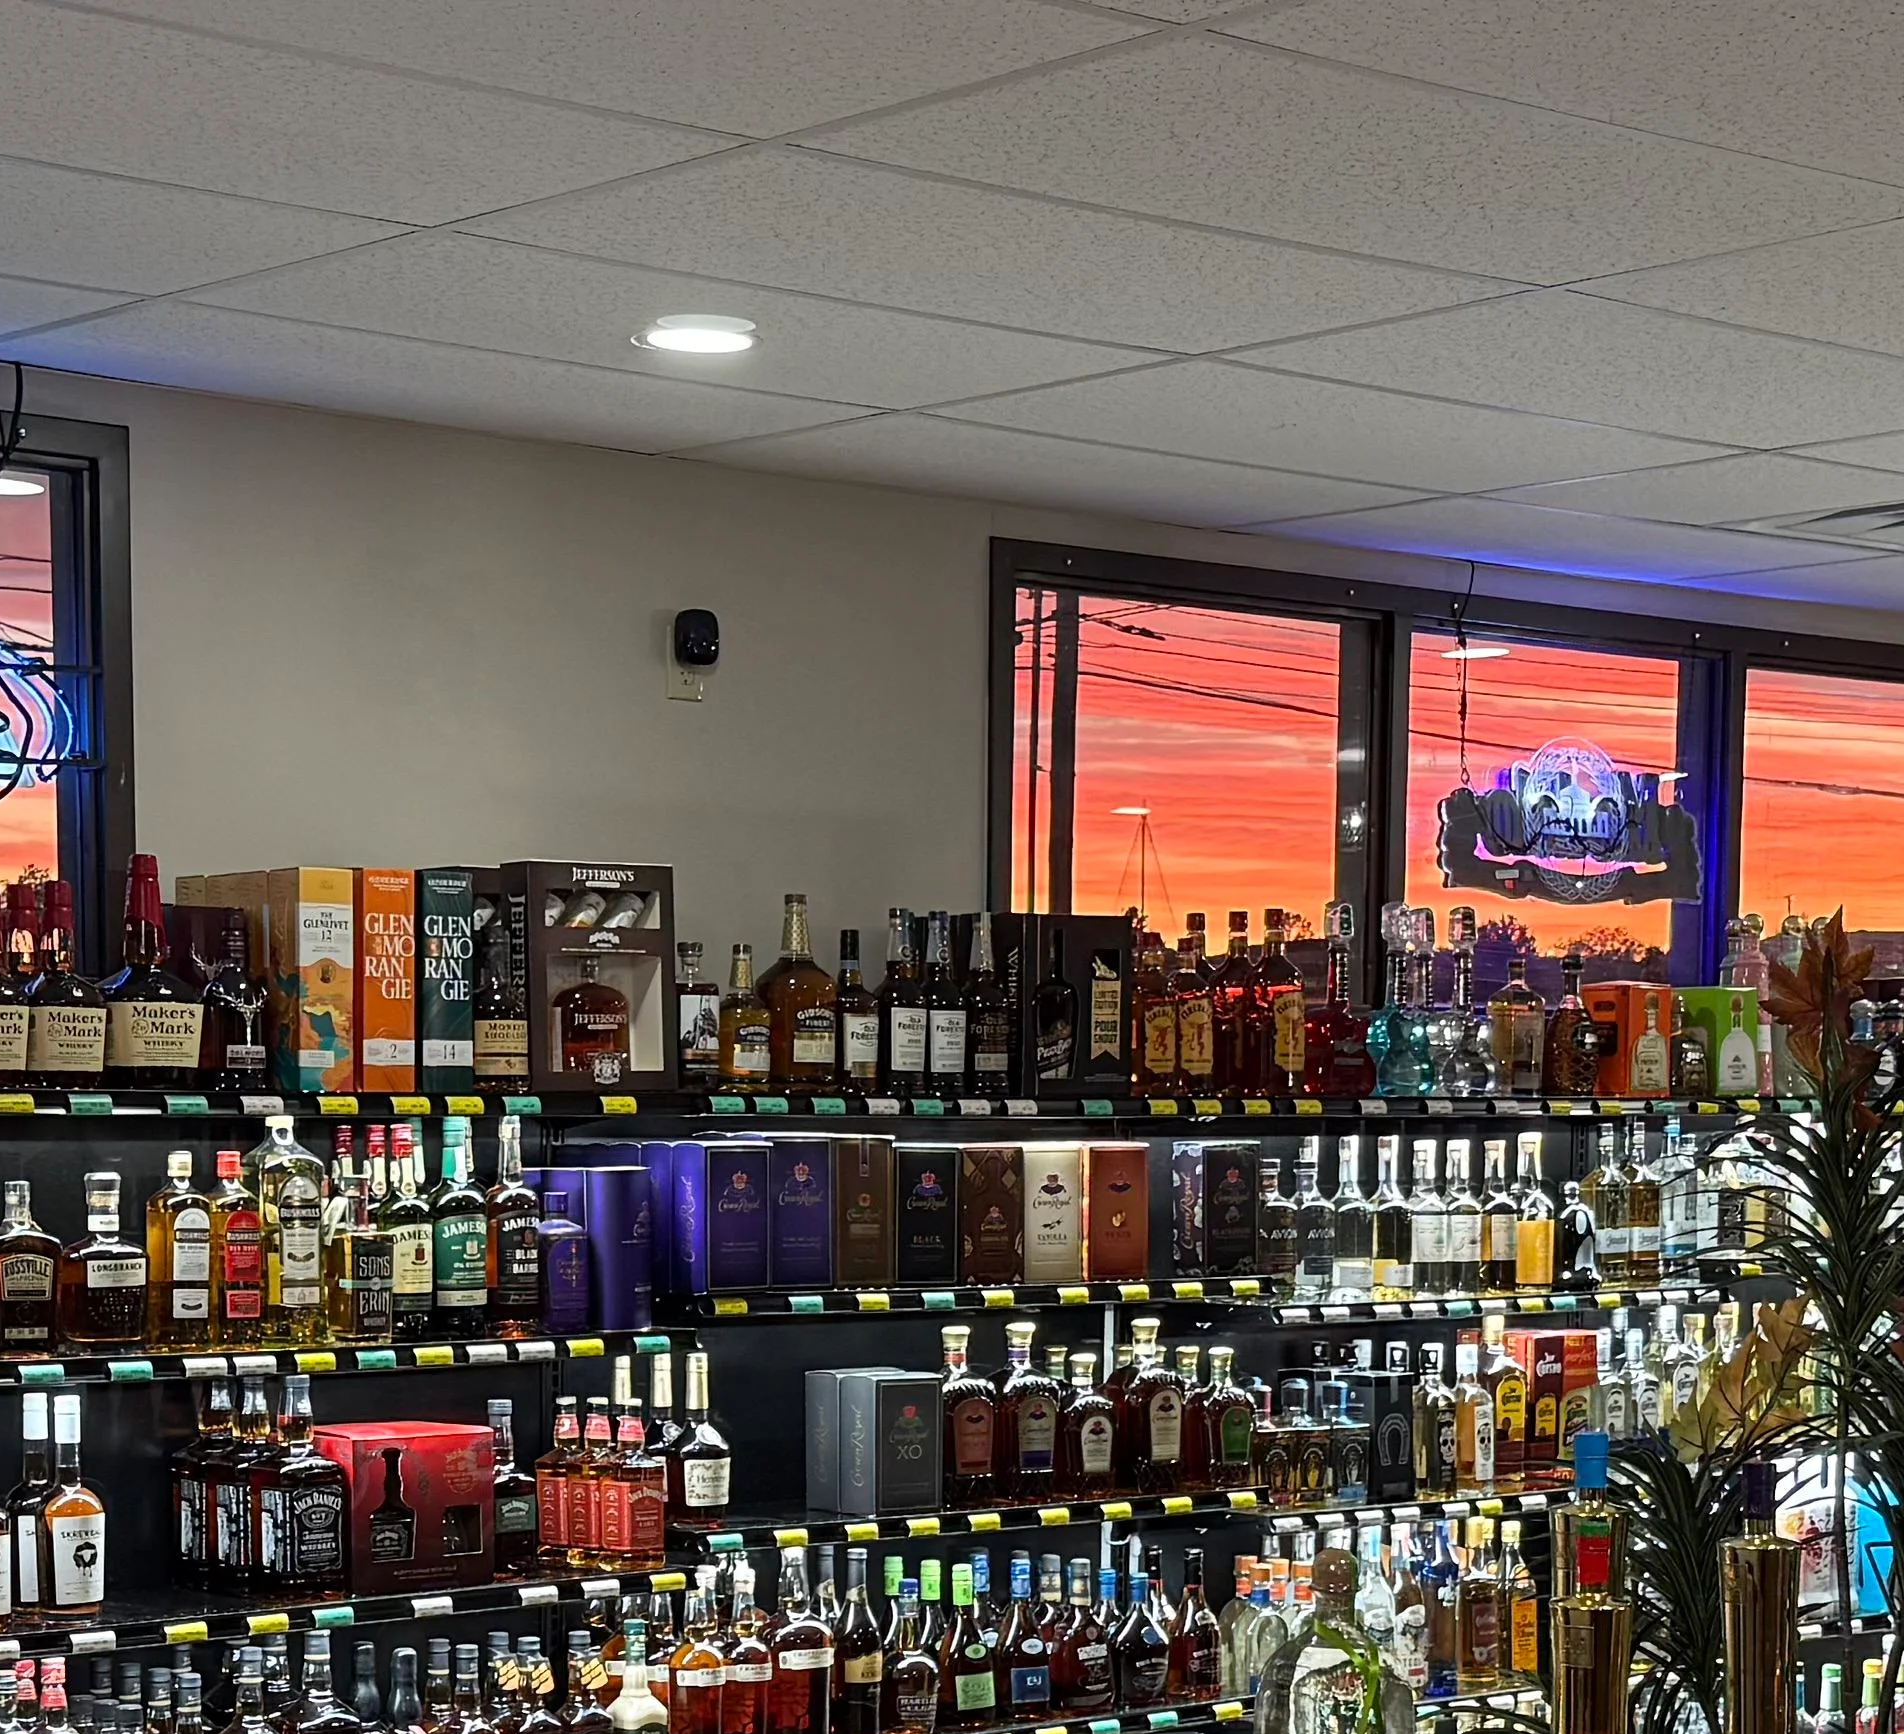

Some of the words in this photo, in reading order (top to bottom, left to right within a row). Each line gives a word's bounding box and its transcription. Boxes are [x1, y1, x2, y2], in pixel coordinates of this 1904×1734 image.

[572, 867, 635, 882] JEFFERSON'S
[303, 920, 348, 930] GLENLIVET
[365, 914, 414, 934] GLEN
[424, 916, 471, 937] GLEN
[321, 930, 332, 941] 12
[383, 937, 415, 957] MO
[443, 938, 473, 958] MO
[365, 958, 404, 977] RAN
[425, 959, 462, 978] RAN
[382, 980, 411, 999] GIE
[441, 980, 469, 1000] GIE
[48, 1011, 103, 1023] Maker's
[132, 1006, 195, 1019] Maker's
[64, 1026, 102, 1037] Mark
[151, 1022, 194, 1034] Mark
[442, 1044, 456, 1059] 14
[359, 1256, 390, 1277] SONS
[359, 1292, 390, 1315] ERIN
[897, 1444, 922, 1460] XO
[295, 1499, 313, 1513] JACK
